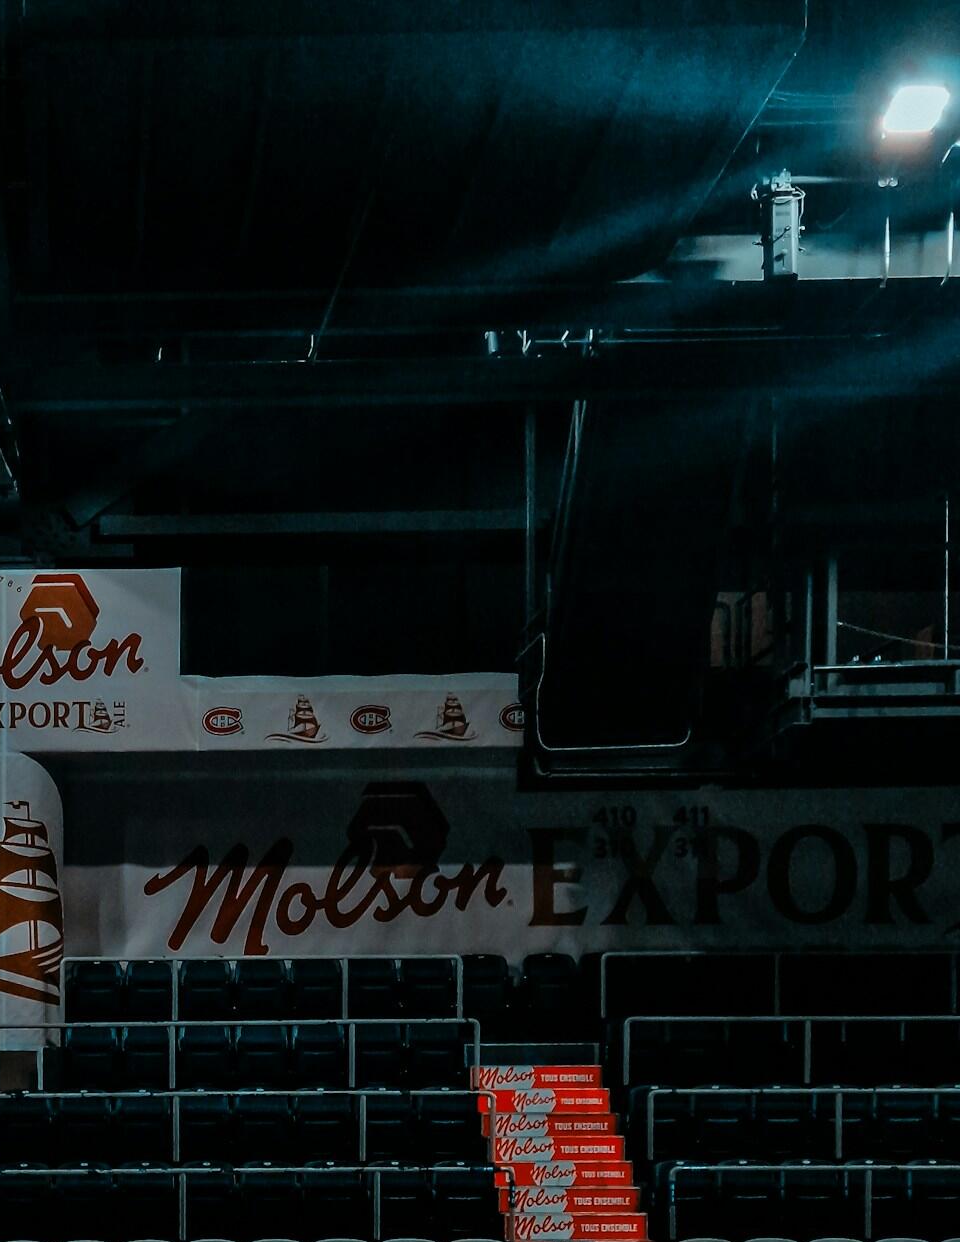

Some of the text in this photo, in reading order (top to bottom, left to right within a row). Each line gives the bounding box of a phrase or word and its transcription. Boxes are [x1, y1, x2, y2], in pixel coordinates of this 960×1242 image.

[114, 700, 125, 728] ALE
[593, 805, 637, 827] 410
[673, 805, 708, 827] 411
[143, 838, 507, 955] Molson
